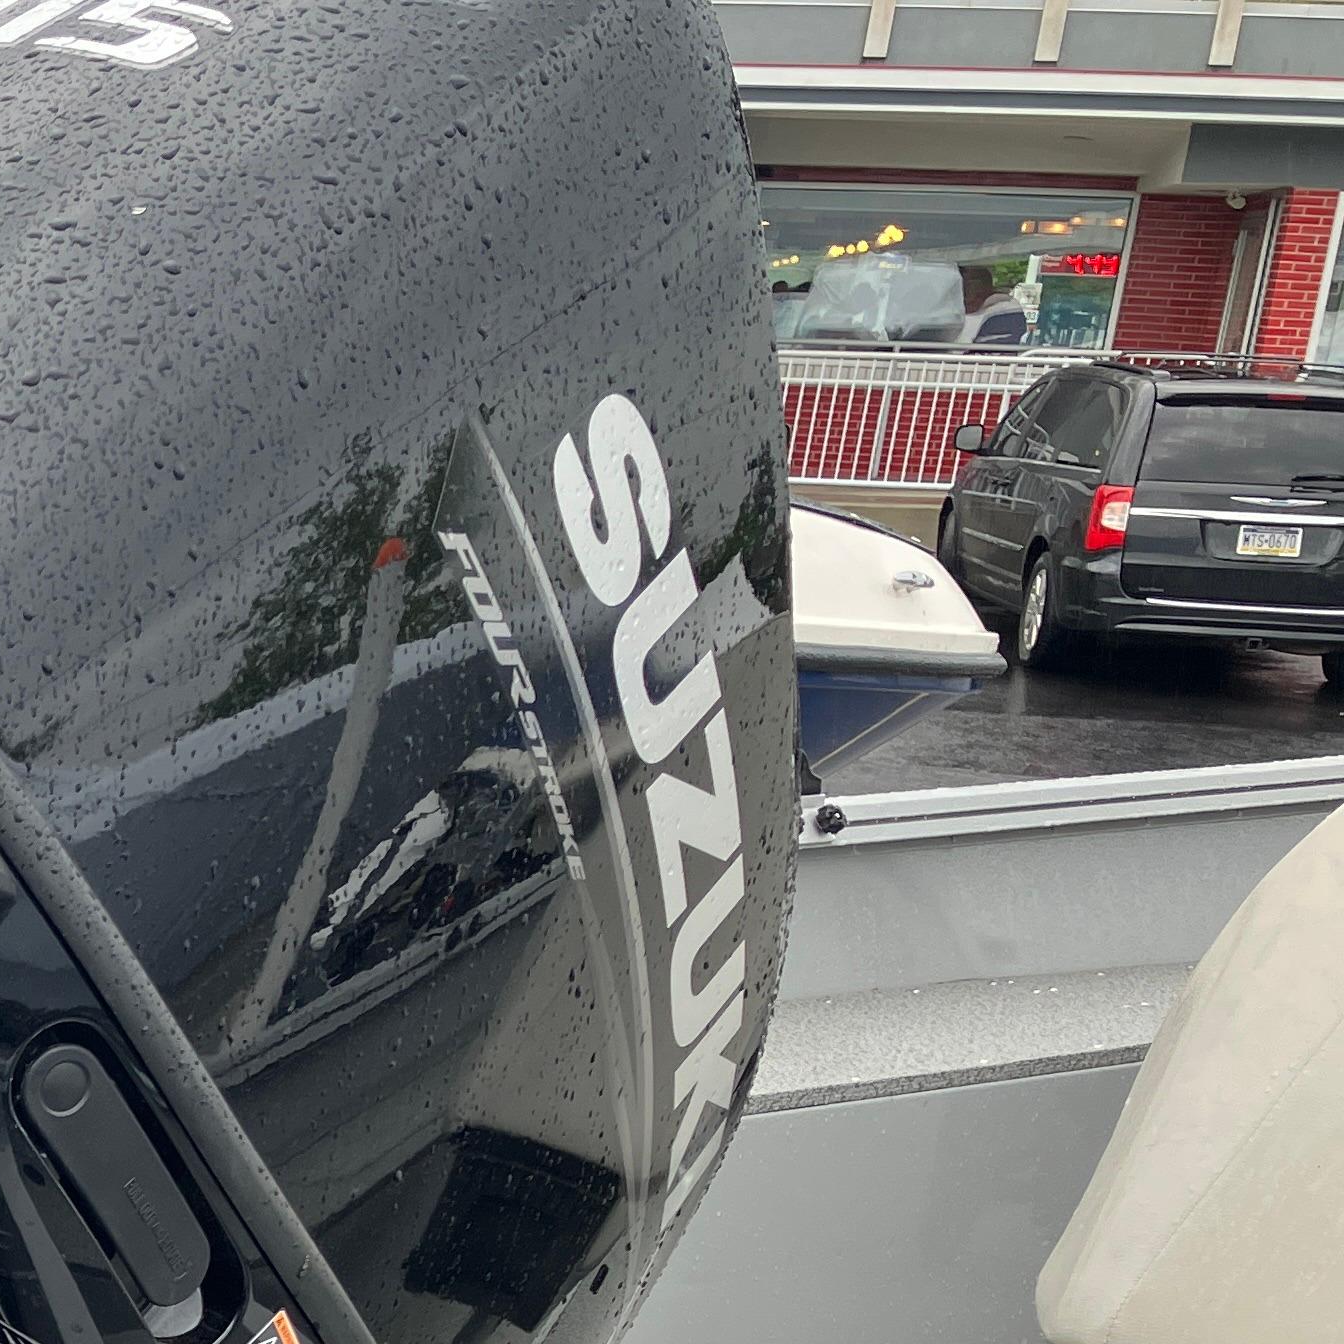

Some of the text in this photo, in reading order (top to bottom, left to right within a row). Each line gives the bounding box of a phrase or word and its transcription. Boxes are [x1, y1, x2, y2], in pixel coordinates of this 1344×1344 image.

[437, 531, 587, 881] FOUR STROKE
[553, 393, 745, 1232] SUZUKI
